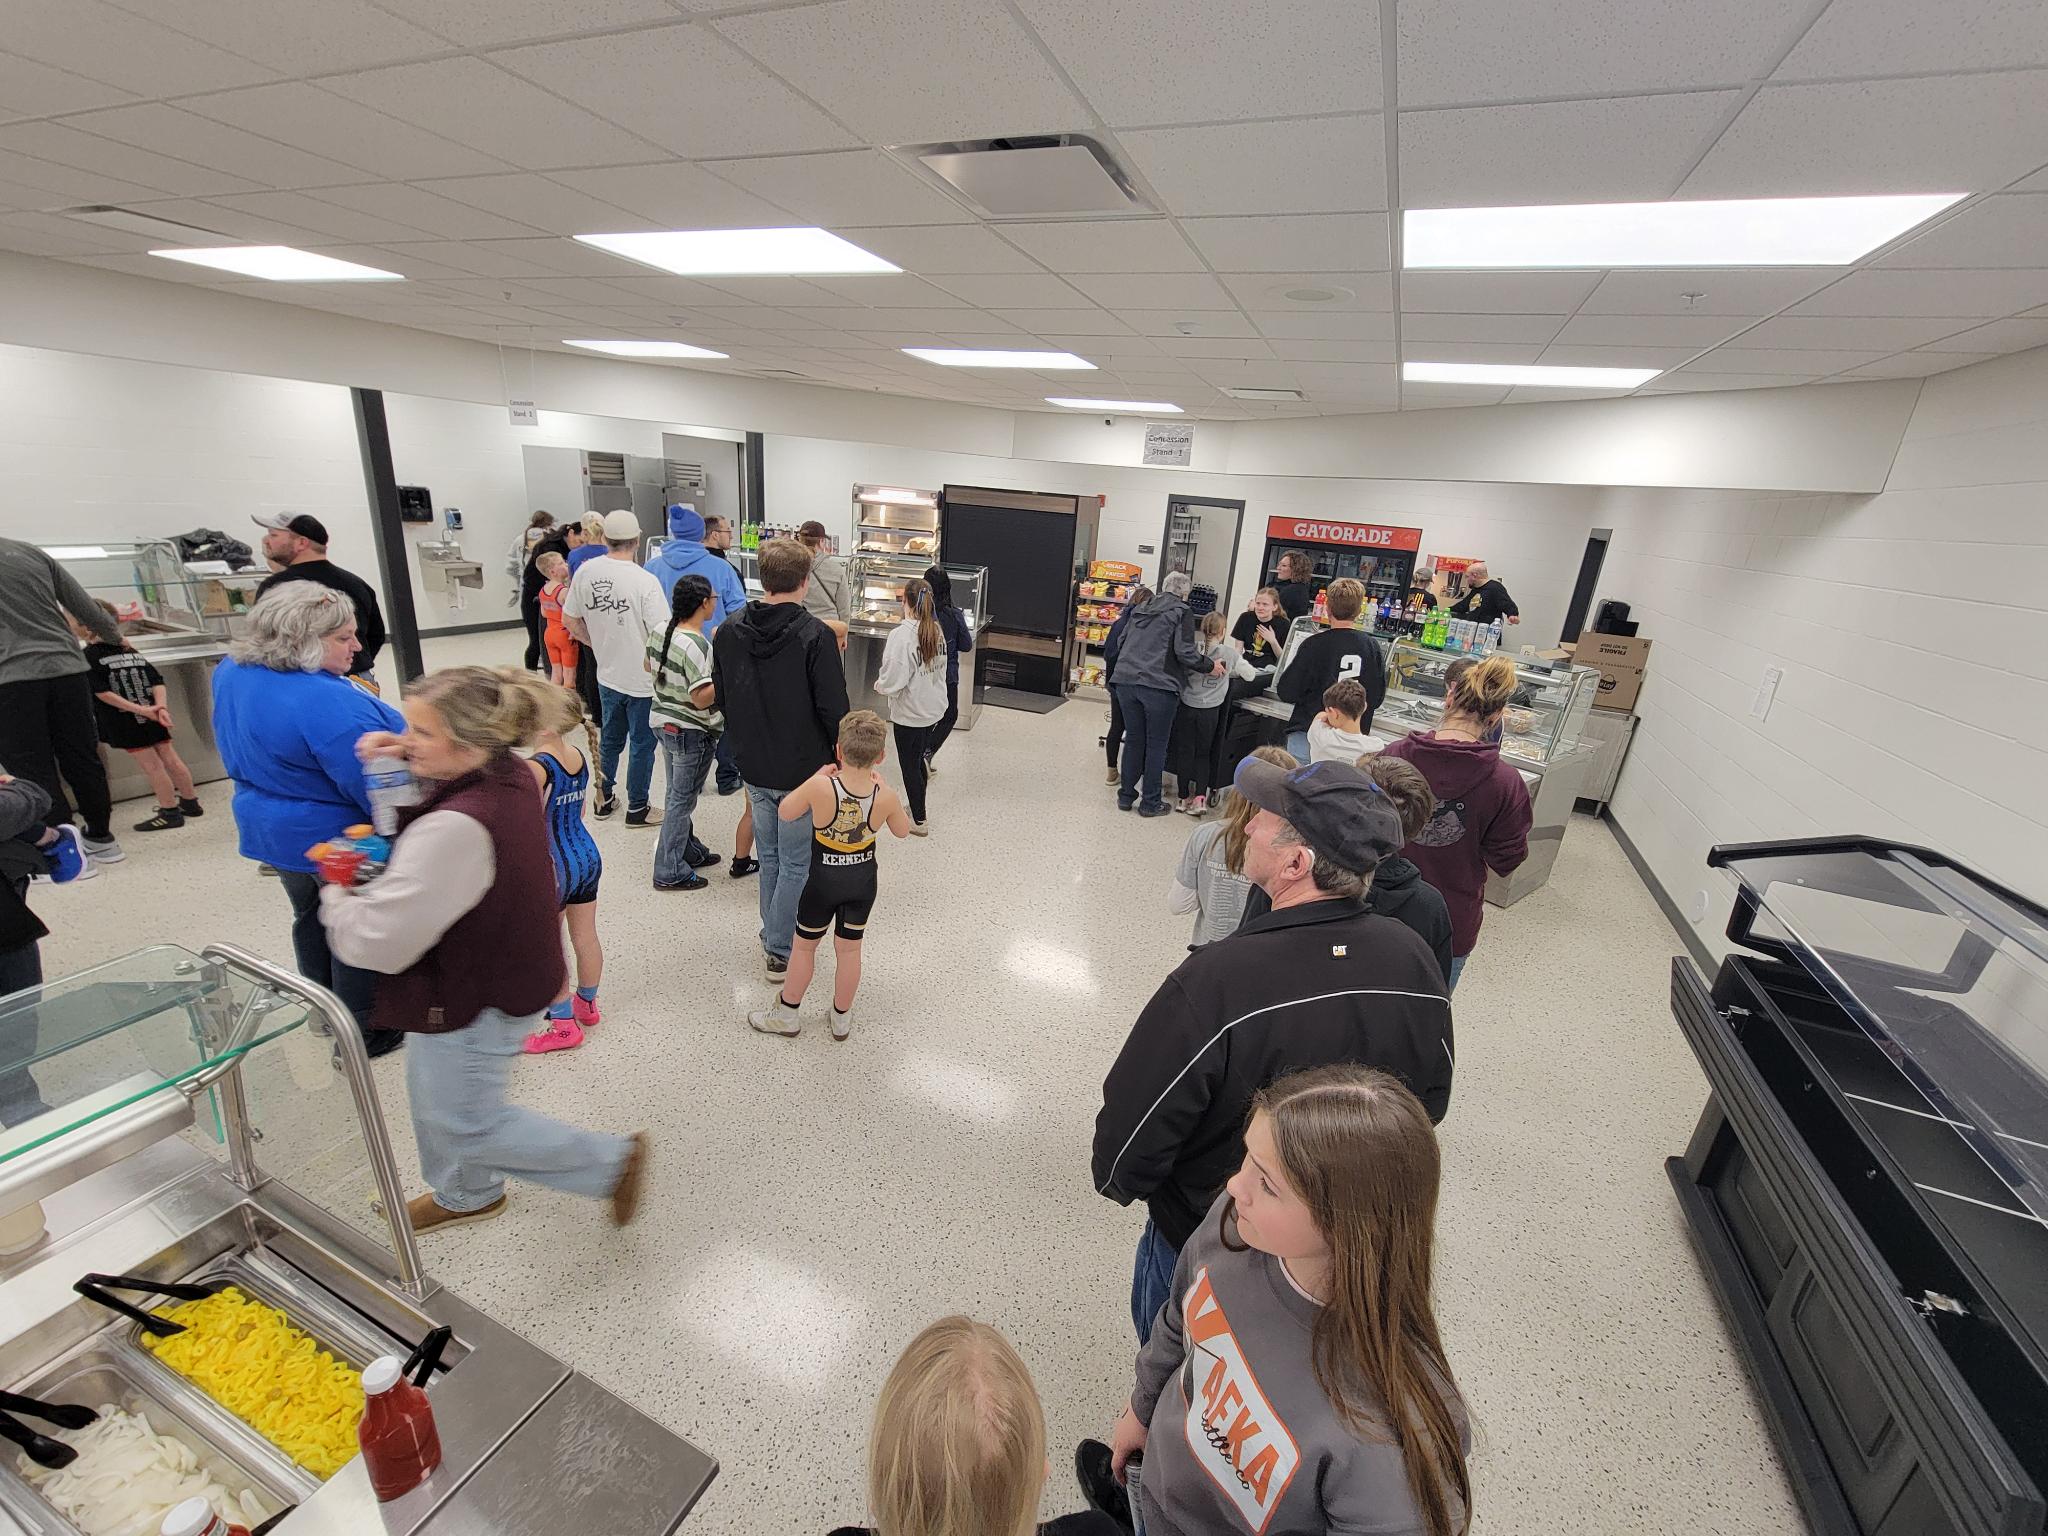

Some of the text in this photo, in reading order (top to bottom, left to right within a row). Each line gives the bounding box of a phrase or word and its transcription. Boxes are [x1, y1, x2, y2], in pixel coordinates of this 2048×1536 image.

[1148, 433, 1190, 444] Concession
[1152, 448, 1173, 456] Stand
[1293, 522, 1393, 546] GATORADE
[585, 592, 630, 615] JESUS
[1599, 647, 1627, 656] FRAGILE
[1337, 654, 1362, 684] 2
[822, 850, 873, 866] KERNELS
[1332, 945, 1348, 957] CAT
